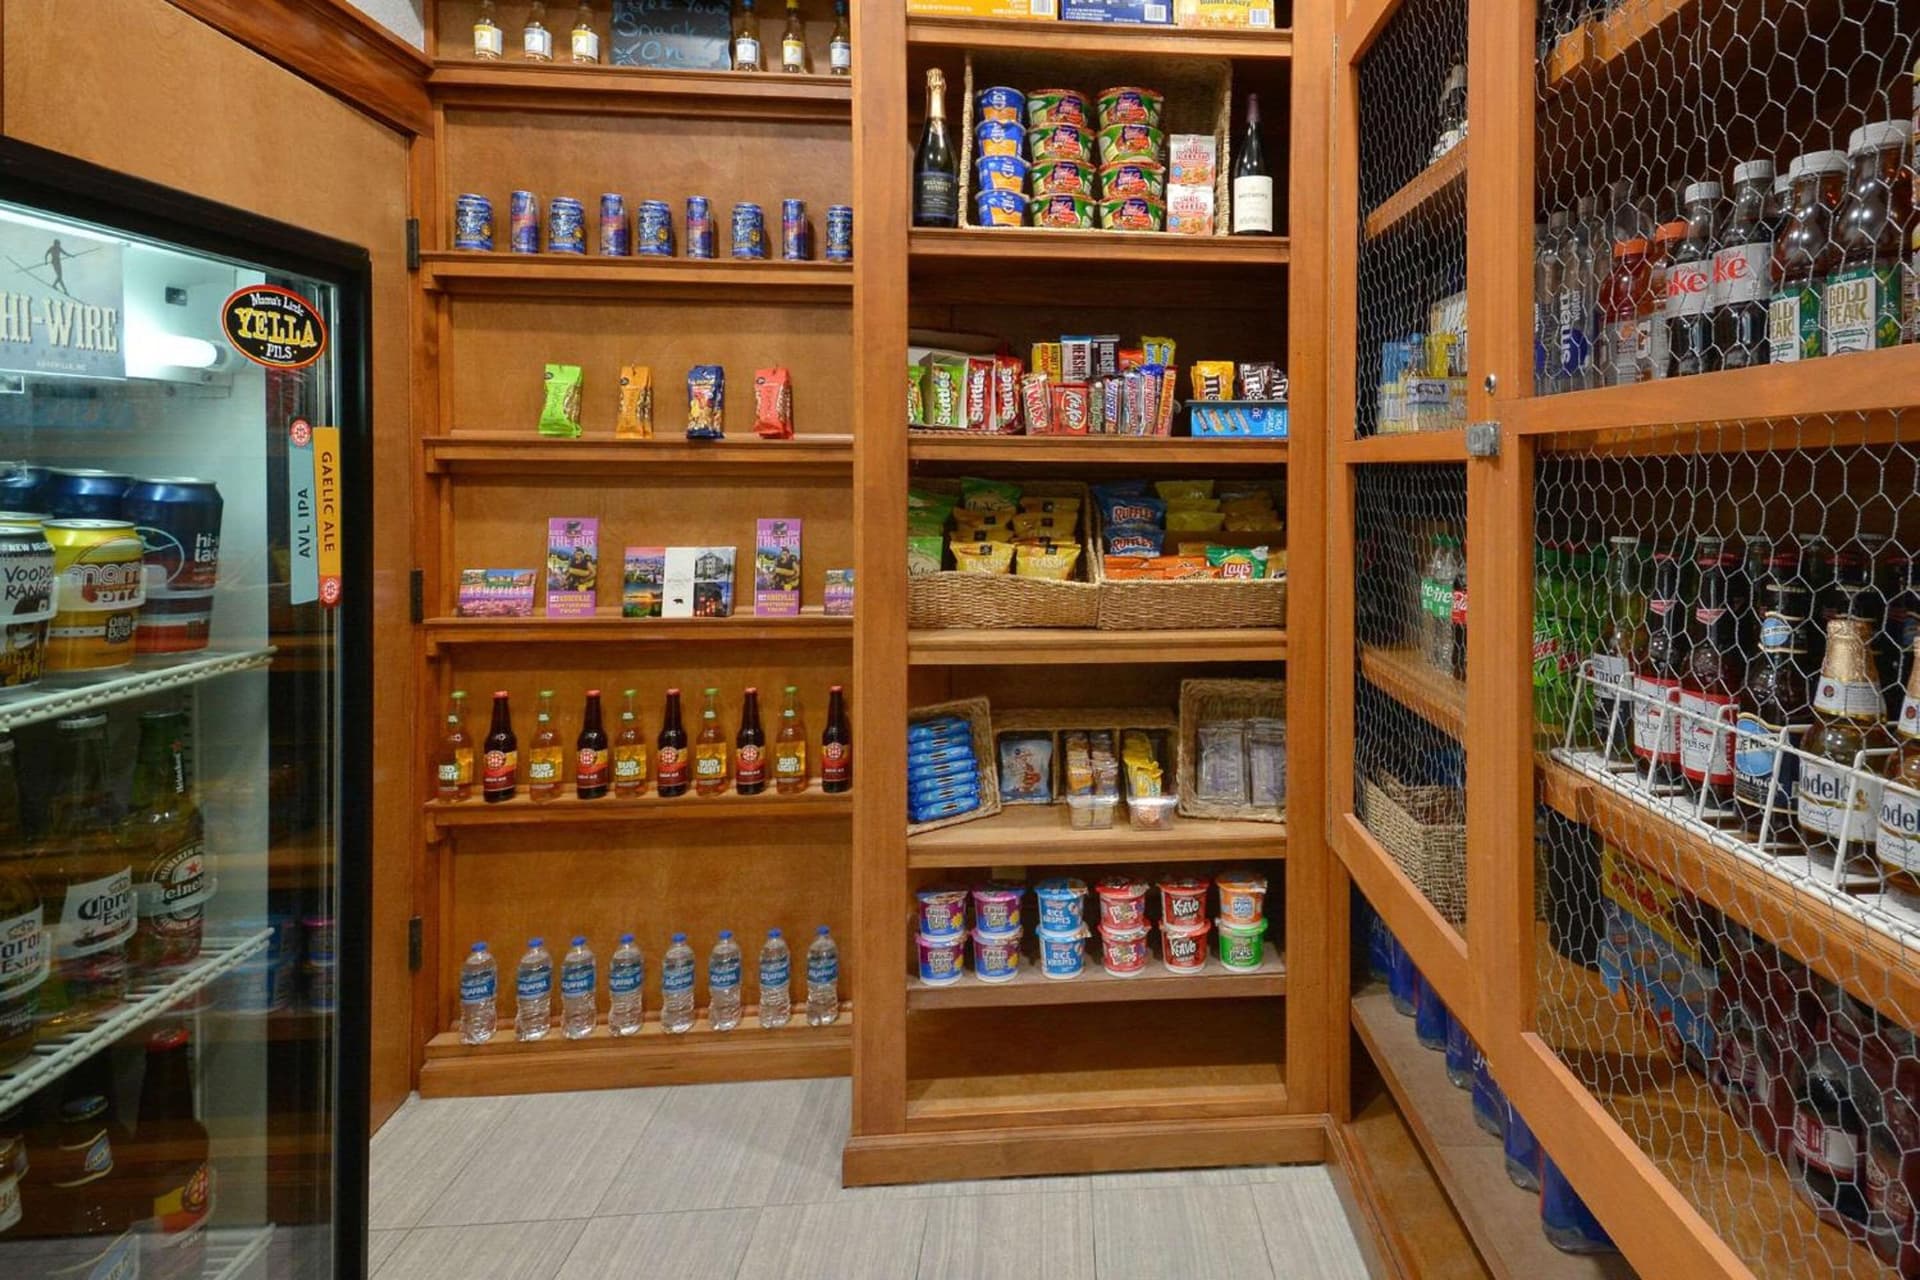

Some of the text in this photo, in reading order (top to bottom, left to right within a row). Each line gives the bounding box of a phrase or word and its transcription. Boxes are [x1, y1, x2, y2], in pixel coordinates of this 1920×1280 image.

[617, 12, 695, 37] Snack
[641, 41, 684, 60] On
[1829, 281, 1868, 307] GOLD
[1829, 301, 1868, 327] PEAK
[234, 307, 318, 348] YELLA
[266, 343, 292, 359] PILS
[937, 371, 952, 426] Skittles
[970, 368, 986, 422] Skittles
[1000, 366, 1017, 421] Skittles
[321, 451, 336, 552] GAELIC ALE
[297, 488, 311, 558] AVL IPA
[573, 535, 595, 547] BUS
[1172, 898, 1199, 916] Krave
[1169, 940, 1197, 957] Krave
